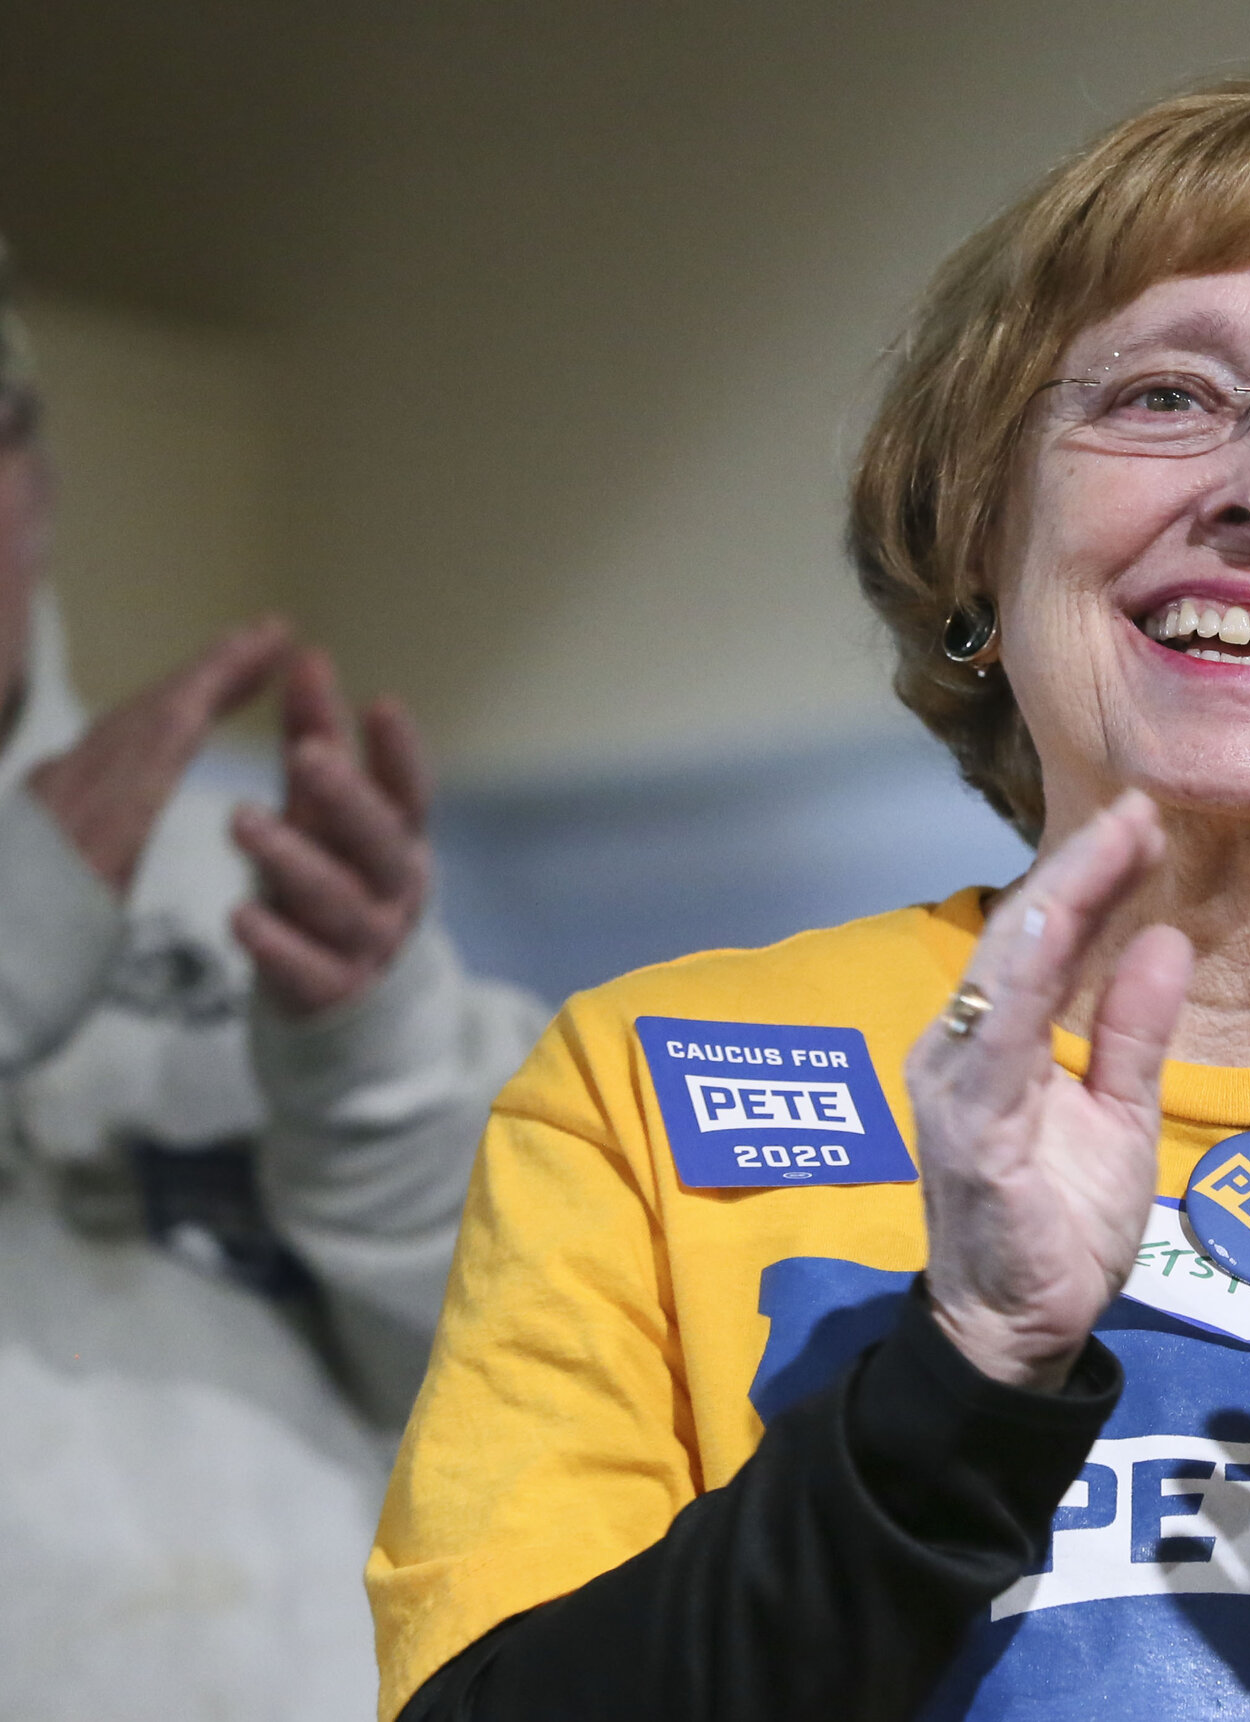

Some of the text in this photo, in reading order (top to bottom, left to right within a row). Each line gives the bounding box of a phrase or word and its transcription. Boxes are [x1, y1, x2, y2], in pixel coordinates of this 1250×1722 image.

[666, 1040, 849, 1068] CAUCUS FOR
[699, 1085, 847, 1123] PETE
[733, 1145, 850, 1168] 2020
